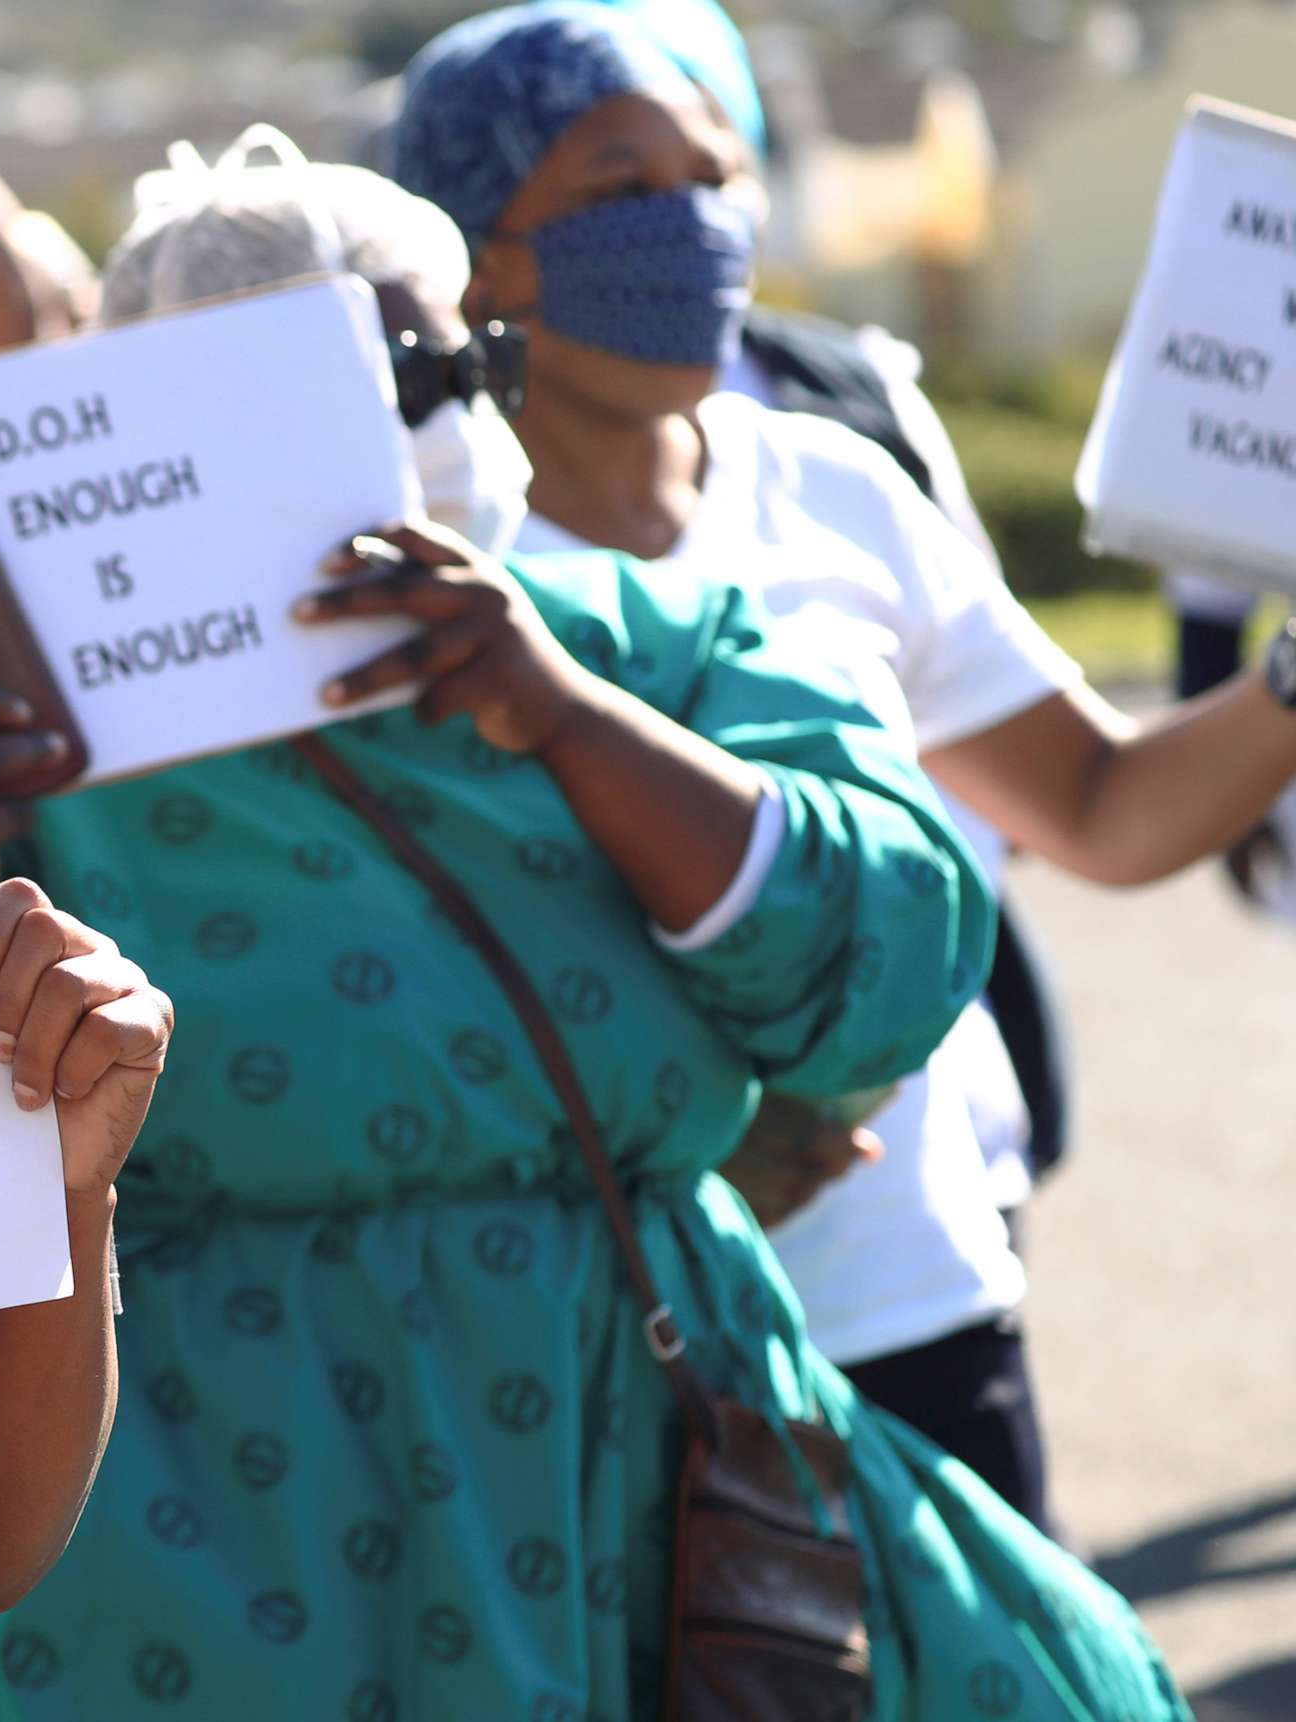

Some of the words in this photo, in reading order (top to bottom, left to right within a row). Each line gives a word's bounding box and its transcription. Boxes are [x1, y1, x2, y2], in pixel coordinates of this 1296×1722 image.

[1157, 330, 1274, 394] AGENCY
[8, 456, 200, 539] ENOUGH
[95, 554, 135, 601] IS
[71, 605, 263, 690] ENOUGH
